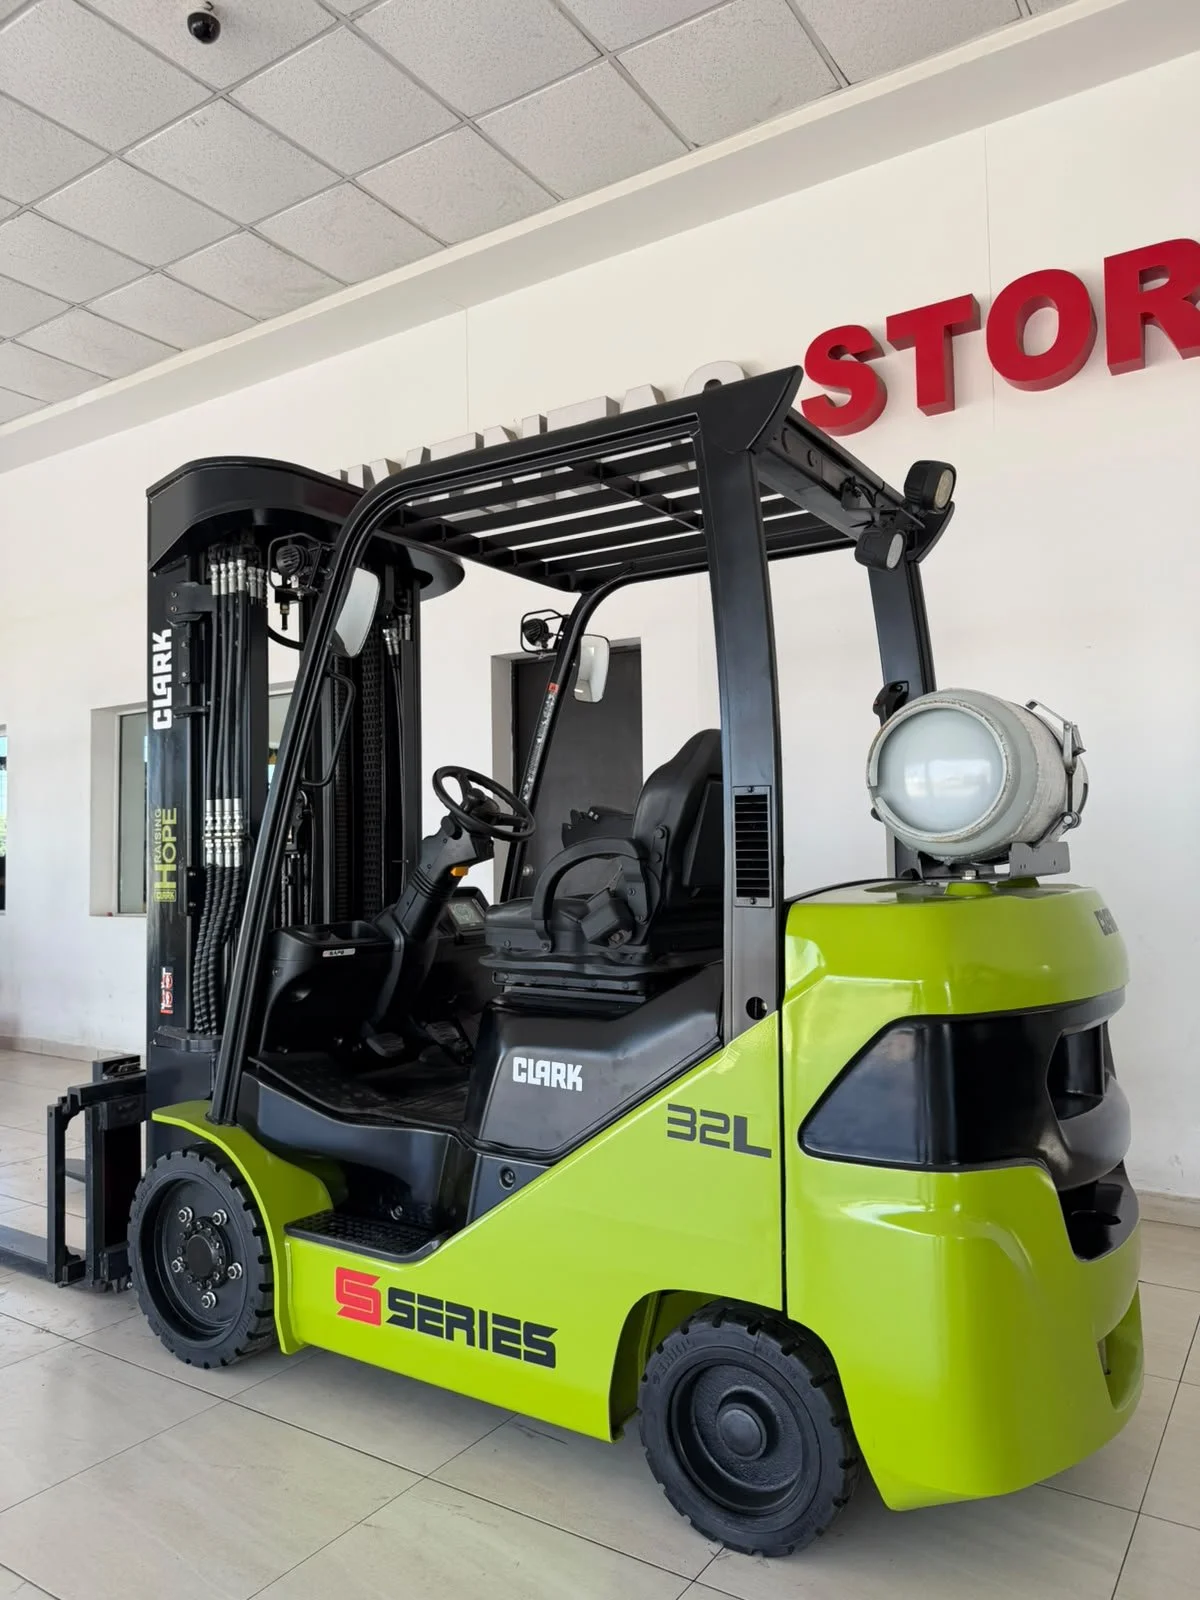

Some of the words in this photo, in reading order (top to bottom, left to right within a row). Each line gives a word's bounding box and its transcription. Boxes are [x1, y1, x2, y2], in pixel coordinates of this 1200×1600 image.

[801, 238, 1200, 437] STOR
[152, 628, 172, 730] CLARK
[154, 808, 162, 864] RAISING
[154, 807, 177, 889] HOPE
[513, 1056, 583, 1092] CLARK
[667, 1103, 772, 1158] 32L
[386, 1286, 558, 1368] SERIES
